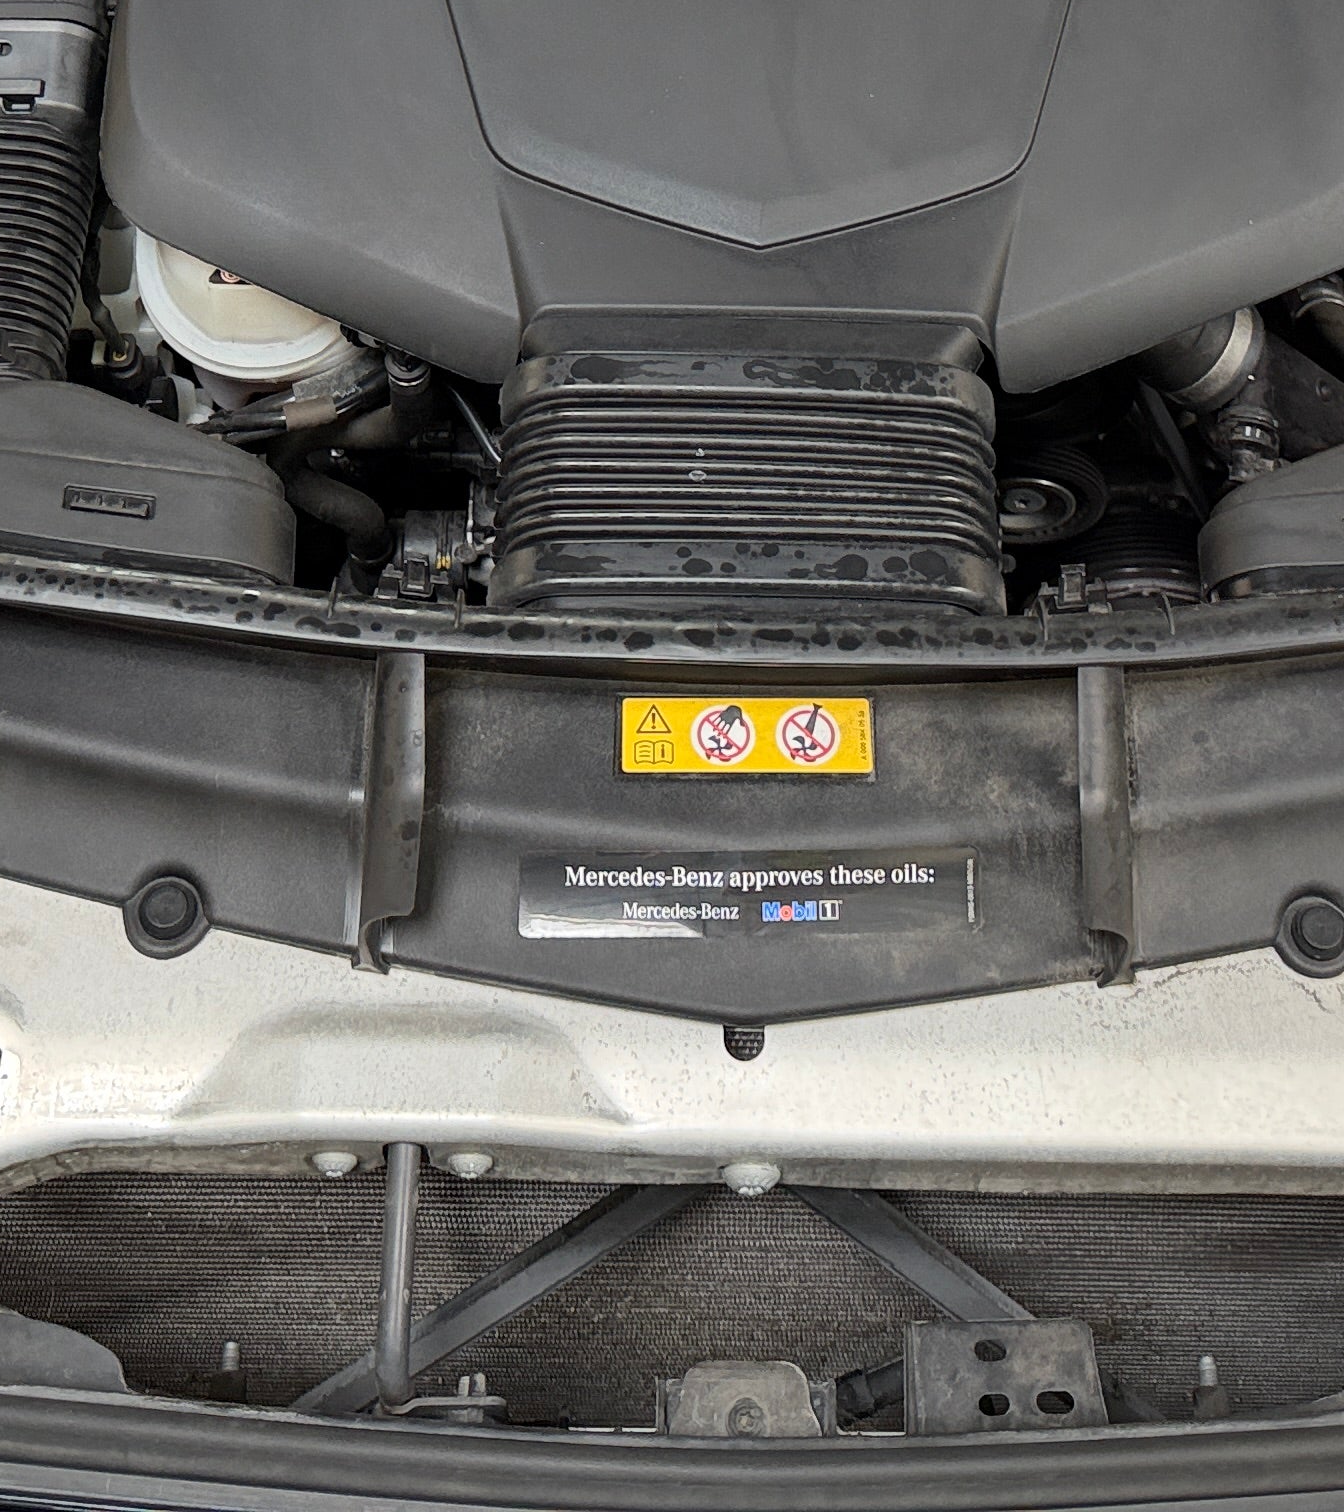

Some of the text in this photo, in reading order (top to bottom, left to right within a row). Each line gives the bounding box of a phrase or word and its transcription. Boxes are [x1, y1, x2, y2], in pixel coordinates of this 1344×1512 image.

[564, 863, 936, 892] Mercedes-Benz approves these oils:
[622, 901, 740, 921] Mercedes-Benz
[760, 900, 817, 922] Mobil
